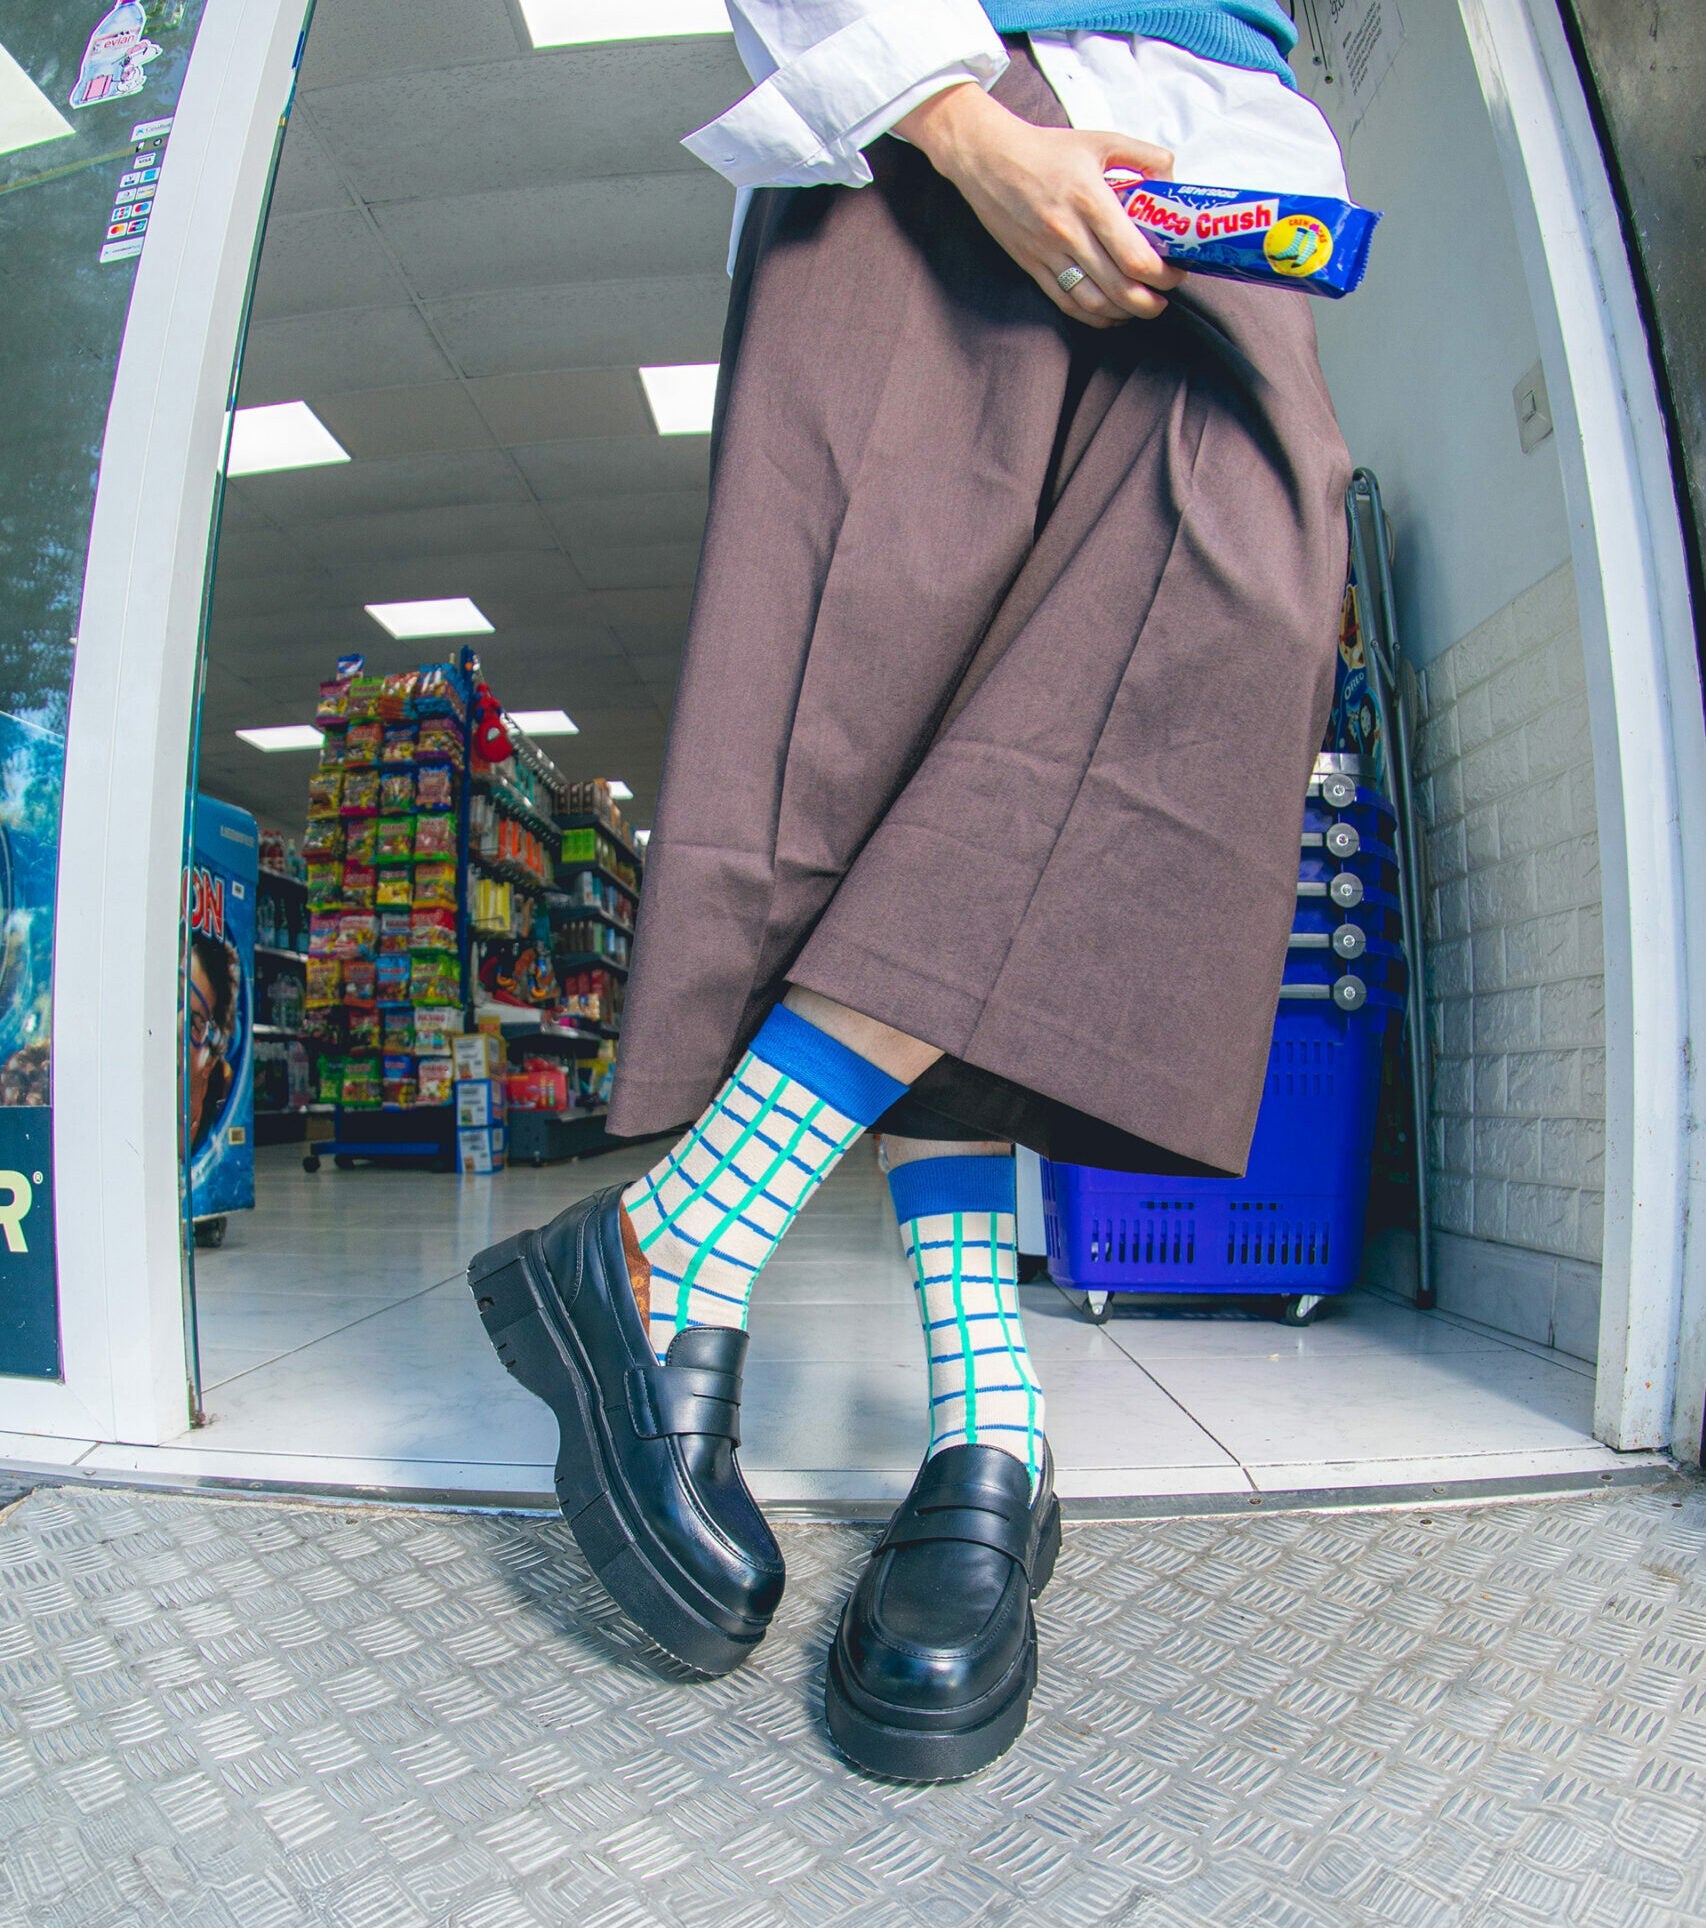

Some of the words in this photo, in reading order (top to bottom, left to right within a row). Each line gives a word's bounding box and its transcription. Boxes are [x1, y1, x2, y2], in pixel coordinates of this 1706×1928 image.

[103, 35, 135, 49] evian
[1128, 193, 1190, 237] Choco
[1196, 205, 1271, 239] Crush
[1344, 672, 1365, 700] OREO
